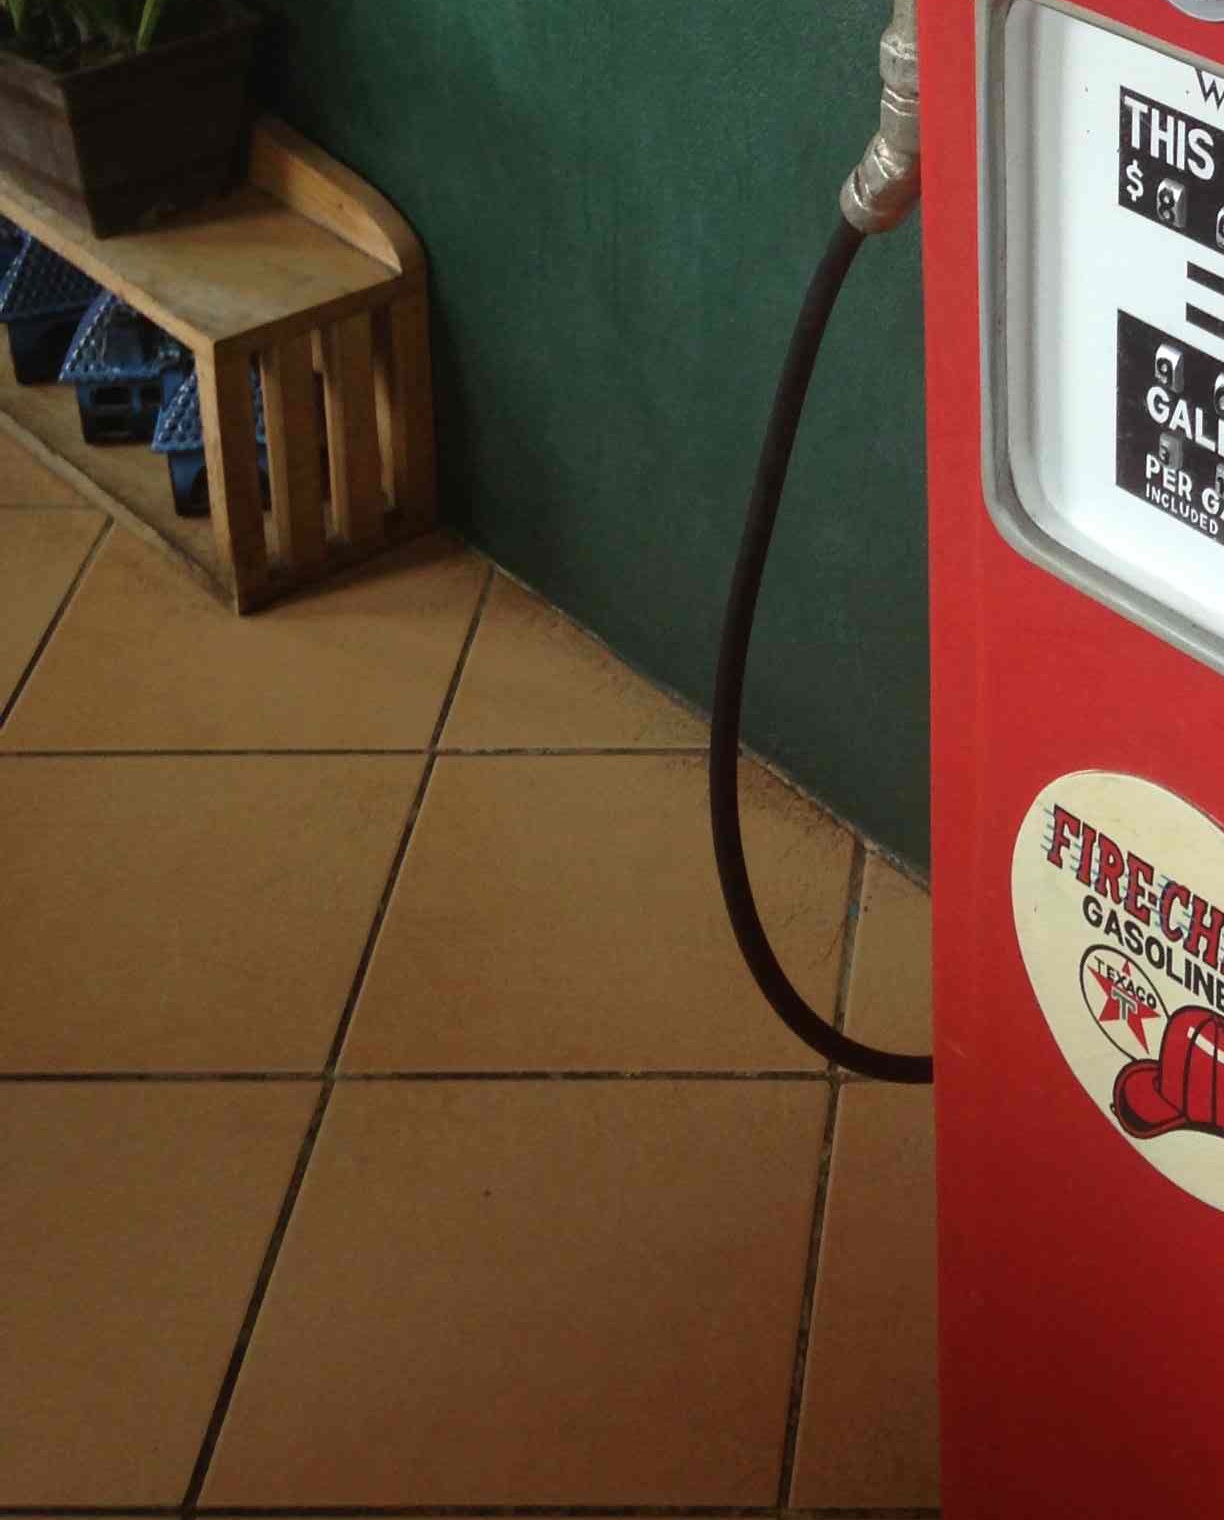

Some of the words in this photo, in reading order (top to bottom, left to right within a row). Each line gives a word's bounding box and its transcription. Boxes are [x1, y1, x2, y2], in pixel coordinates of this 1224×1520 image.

[1123, 94, 1216, 181] THIS
[1125, 159, 1145, 203] $
[1145, 453, 1193, 502] PER
[1145, 482, 1219, 535] INCLUDED
[1094, 955, 1158, 1010] TEXACO
